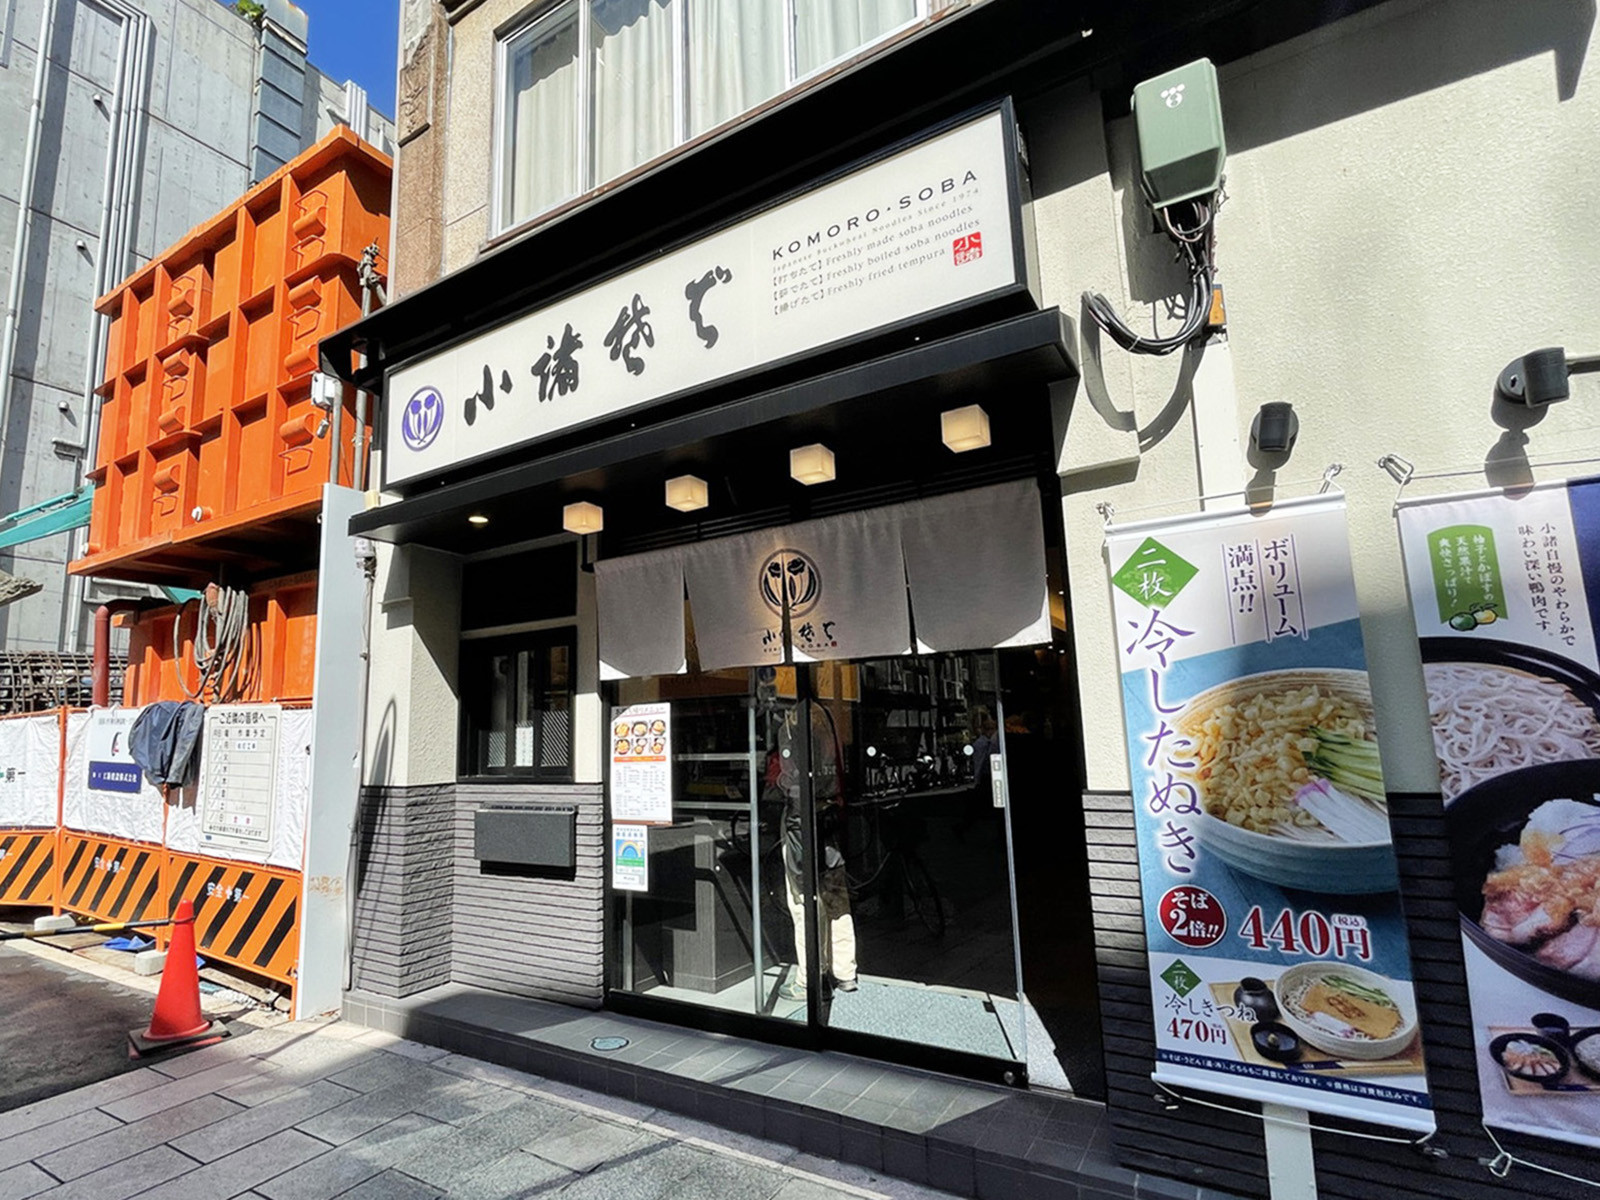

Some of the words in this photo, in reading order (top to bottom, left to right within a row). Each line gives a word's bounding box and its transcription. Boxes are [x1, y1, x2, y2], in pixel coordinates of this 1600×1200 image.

[917, 200, 947, 217] Since
[826, 247, 863, 266] Freshly
[866, 234, 895, 252] made
[899, 222, 924, 239] soba
[927, 206, 973, 228] noodles
[827, 262, 863, 281] Freshly
[867, 246, 901, 266] boiled
[905, 236, 930, 253] soba
[934, 218, 981, 241] noodles
[827, 277, 864, 296] Freshly
[868, 264, 895, 281] fried
[898, 248, 946, 273] tempura
[1137, 547, 1173, 600] 二枚
[1264, 538, 1298, 637] ボリューム
[1539, 522, 1576, 647] 小諸自慢のやわらかで
[1126, 608, 1203, 874] 冷したぬき
[1171, 891, 1209, 909] そば
[1239, 906, 1371, 960] 440円
[1165, 993, 1259, 1023] 冷しきつね
[1167, 1017, 1226, 1045] 470円
